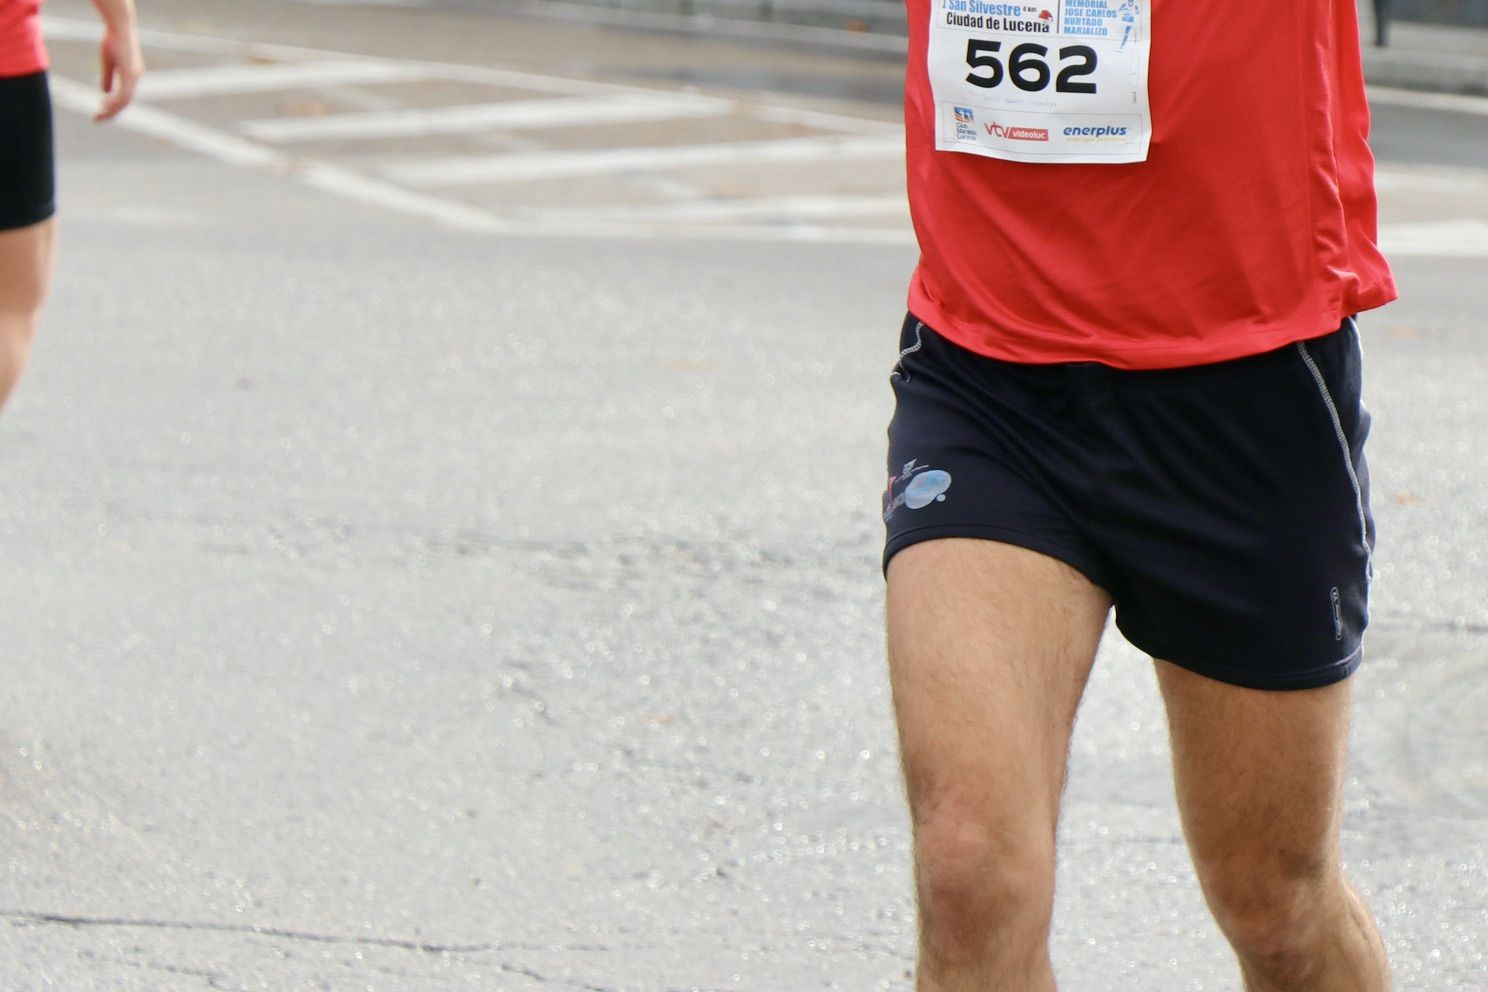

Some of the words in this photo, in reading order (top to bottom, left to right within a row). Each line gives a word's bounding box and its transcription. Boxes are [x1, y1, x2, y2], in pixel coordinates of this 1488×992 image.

[969, 0, 1021, 17] Silvestre
[1065, 0, 1108, 9] MEMORIAL
[1086, 9, 1117, 18] CARLOS
[946, 11, 983, 29] Ciudad
[986, 15, 1000, 30] de
[1003, 18, 1050, 33] Lucena
[1064, 17, 1103, 26] HURTADO
[966, 38, 1098, 94] 562
[1012, 129, 1046, 140] videoluc
[1063, 126, 1127, 137] enerplus
